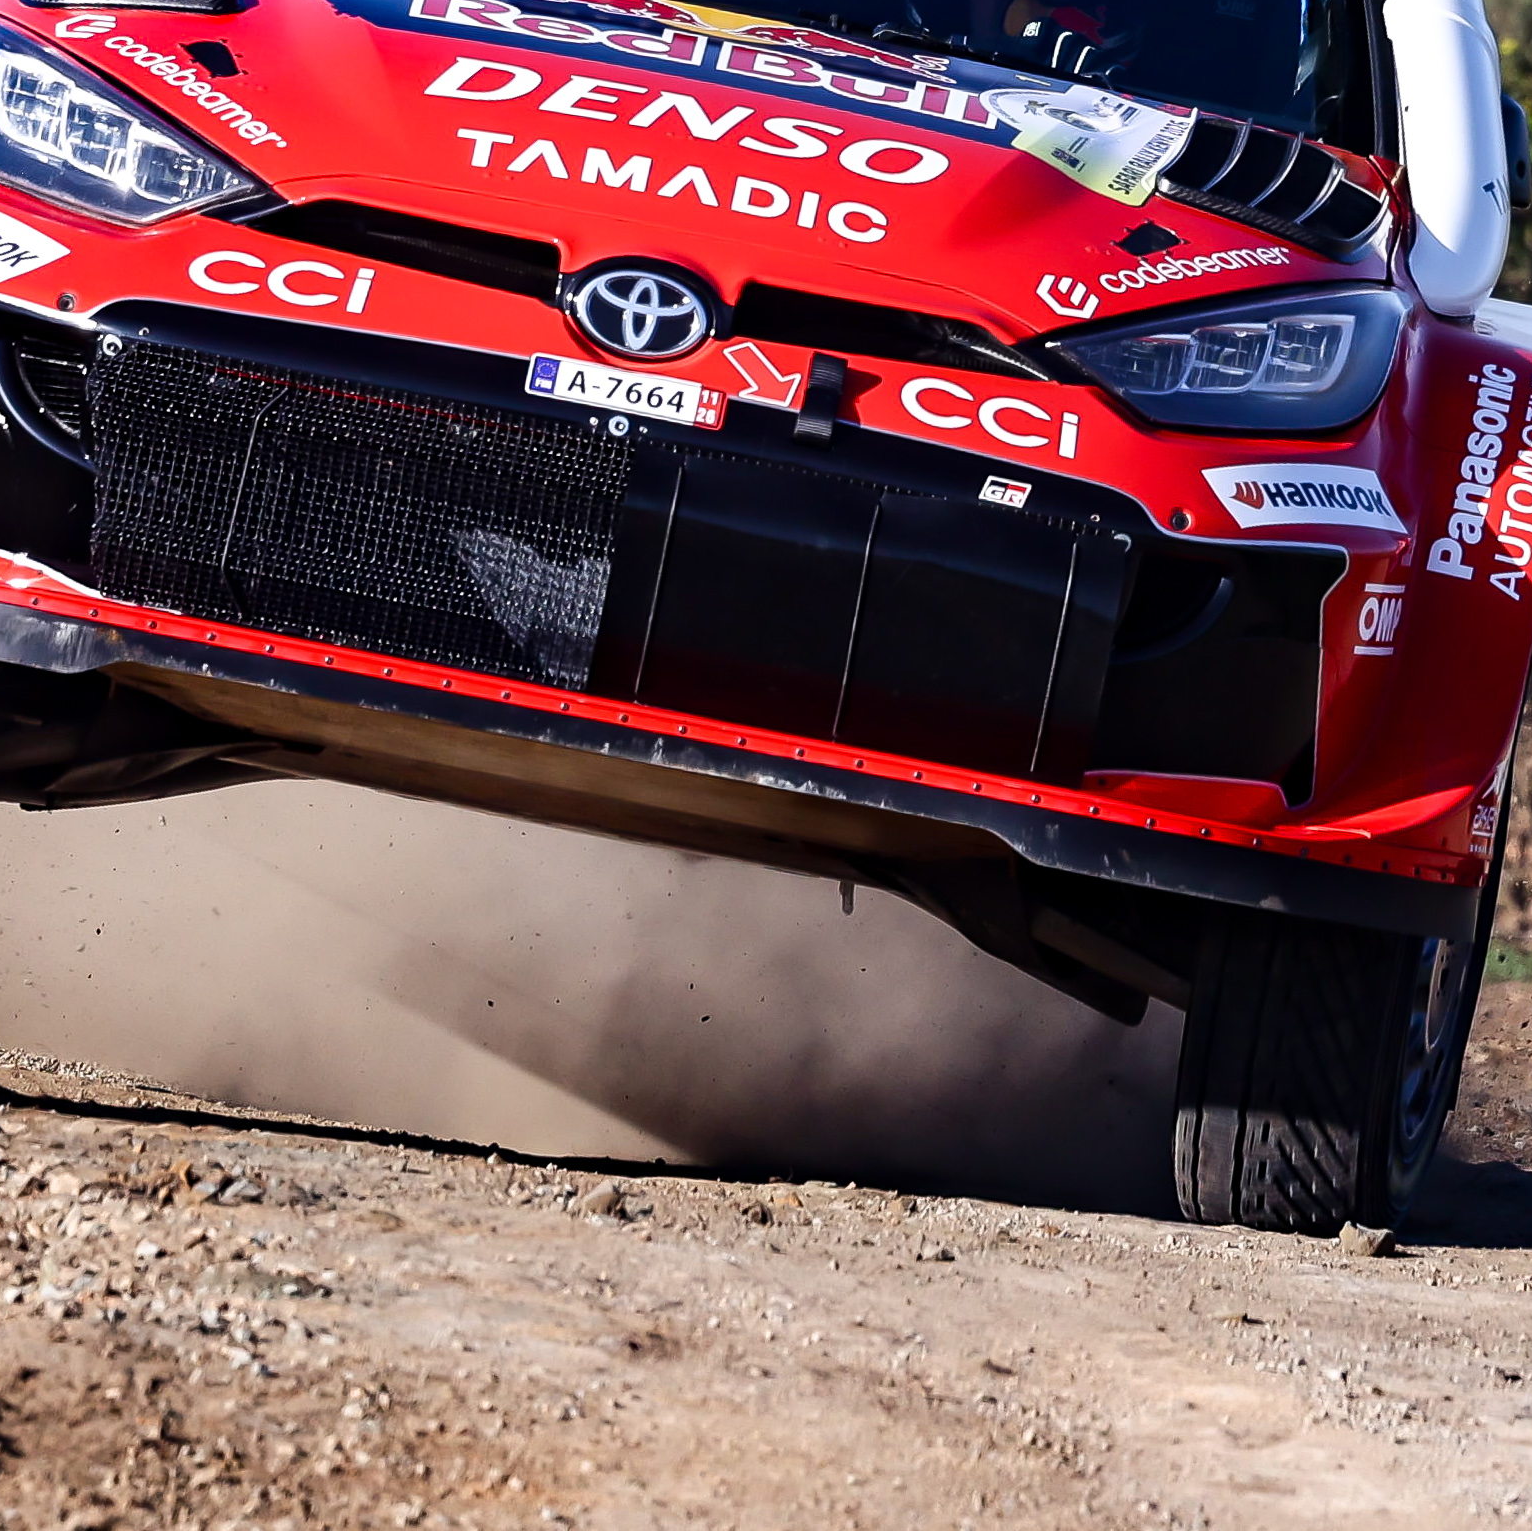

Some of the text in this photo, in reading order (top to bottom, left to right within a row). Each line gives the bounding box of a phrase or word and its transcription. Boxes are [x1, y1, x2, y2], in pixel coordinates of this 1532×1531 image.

[104, 35, 288, 149] codebeamer
[423, 56, 950, 185] DENSO
[715, 39, 999, 130] Bull
[455, 127, 889, 244] TAMADIC
[1098, 246, 1291, 294] codebeamer
[567, 370, 685, 414] A-7664
[700, 388, 720, 407] 11
[981, 482, 1027, 506] GR
[1425, 363, 1517, 581] Panasonic
